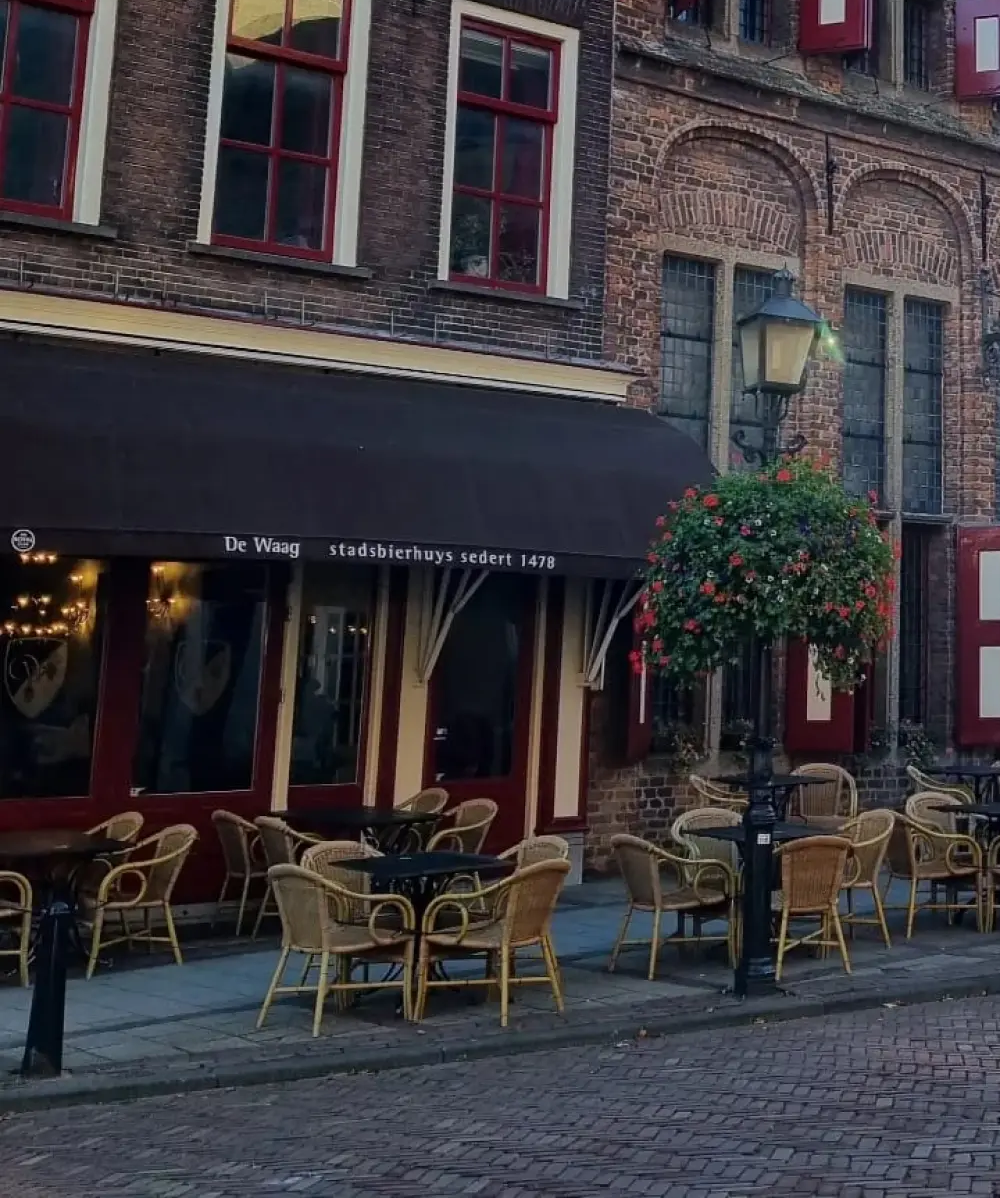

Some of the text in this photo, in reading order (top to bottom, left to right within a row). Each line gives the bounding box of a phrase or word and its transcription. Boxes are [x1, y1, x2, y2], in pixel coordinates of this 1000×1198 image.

[224, 536, 556, 570] De Waag stadsbierhuys sedert 1478
